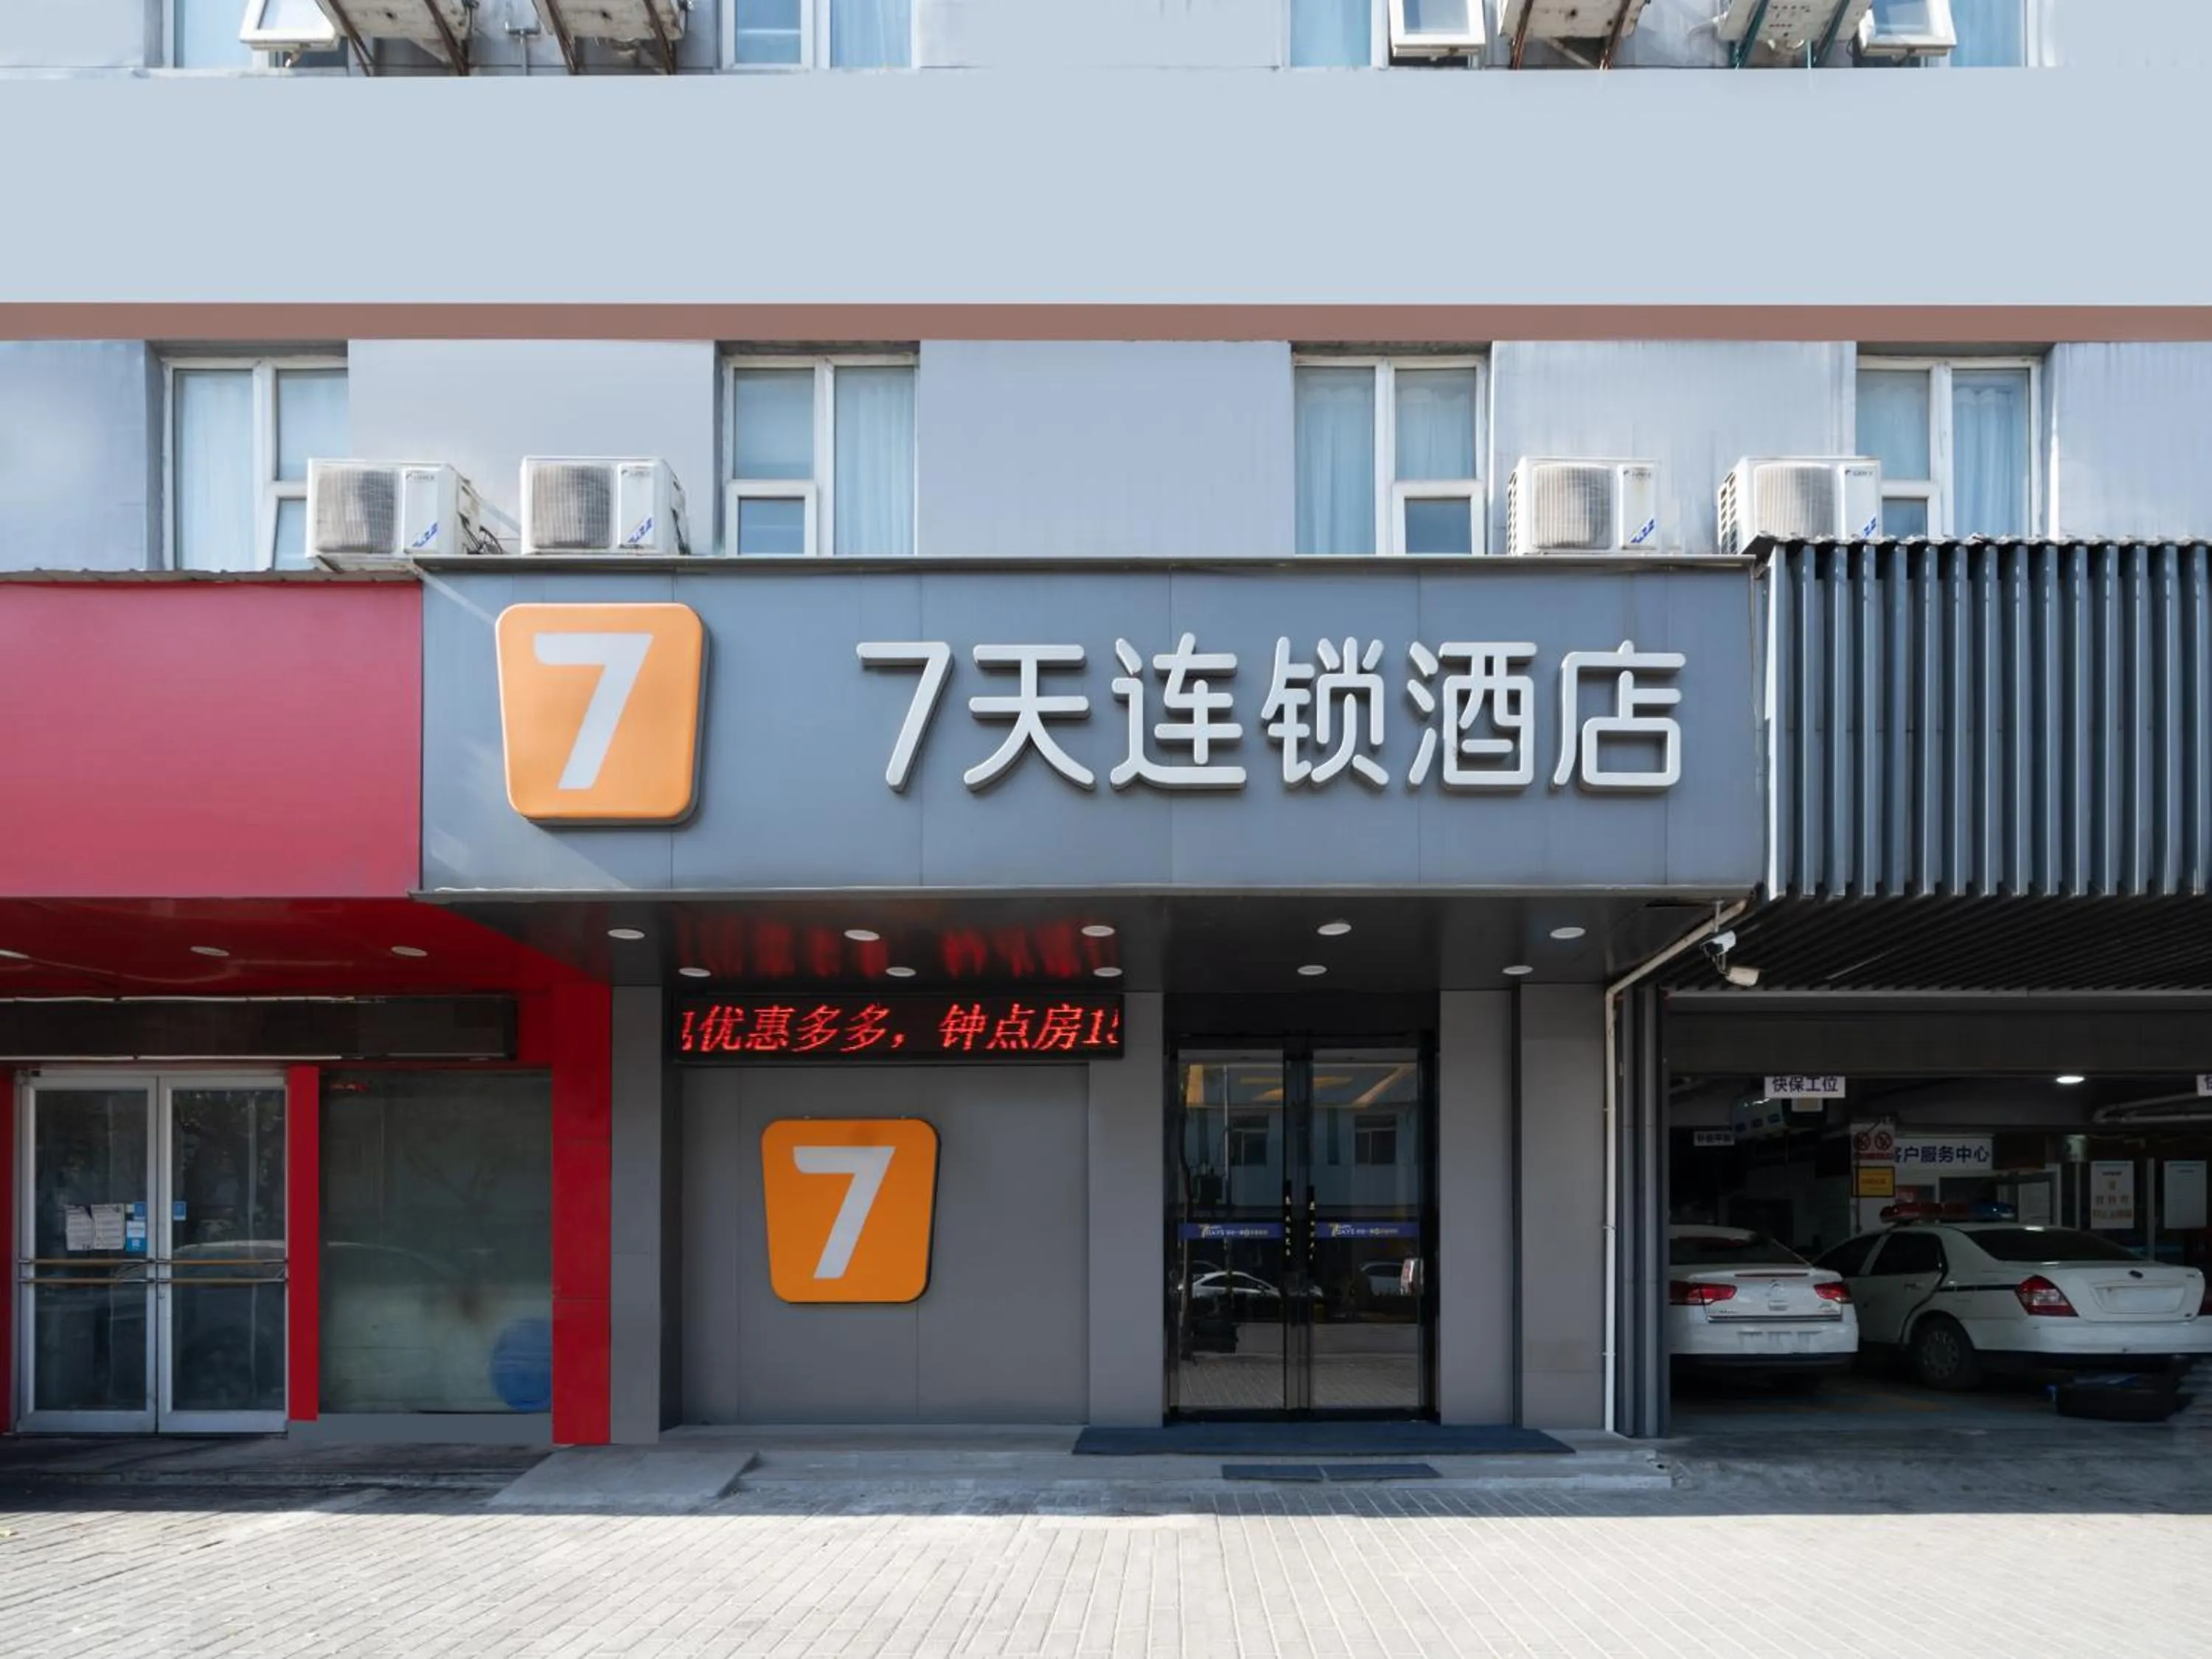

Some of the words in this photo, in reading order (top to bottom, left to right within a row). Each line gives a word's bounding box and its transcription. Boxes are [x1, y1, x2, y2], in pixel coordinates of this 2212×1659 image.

[534, 632, 655, 790] 7
[856, 633, 1687, 793] 7天连锁酒店
[1772, 1076, 1839, 1093] 快保工位
[793, 1145, 897, 1280] 7
